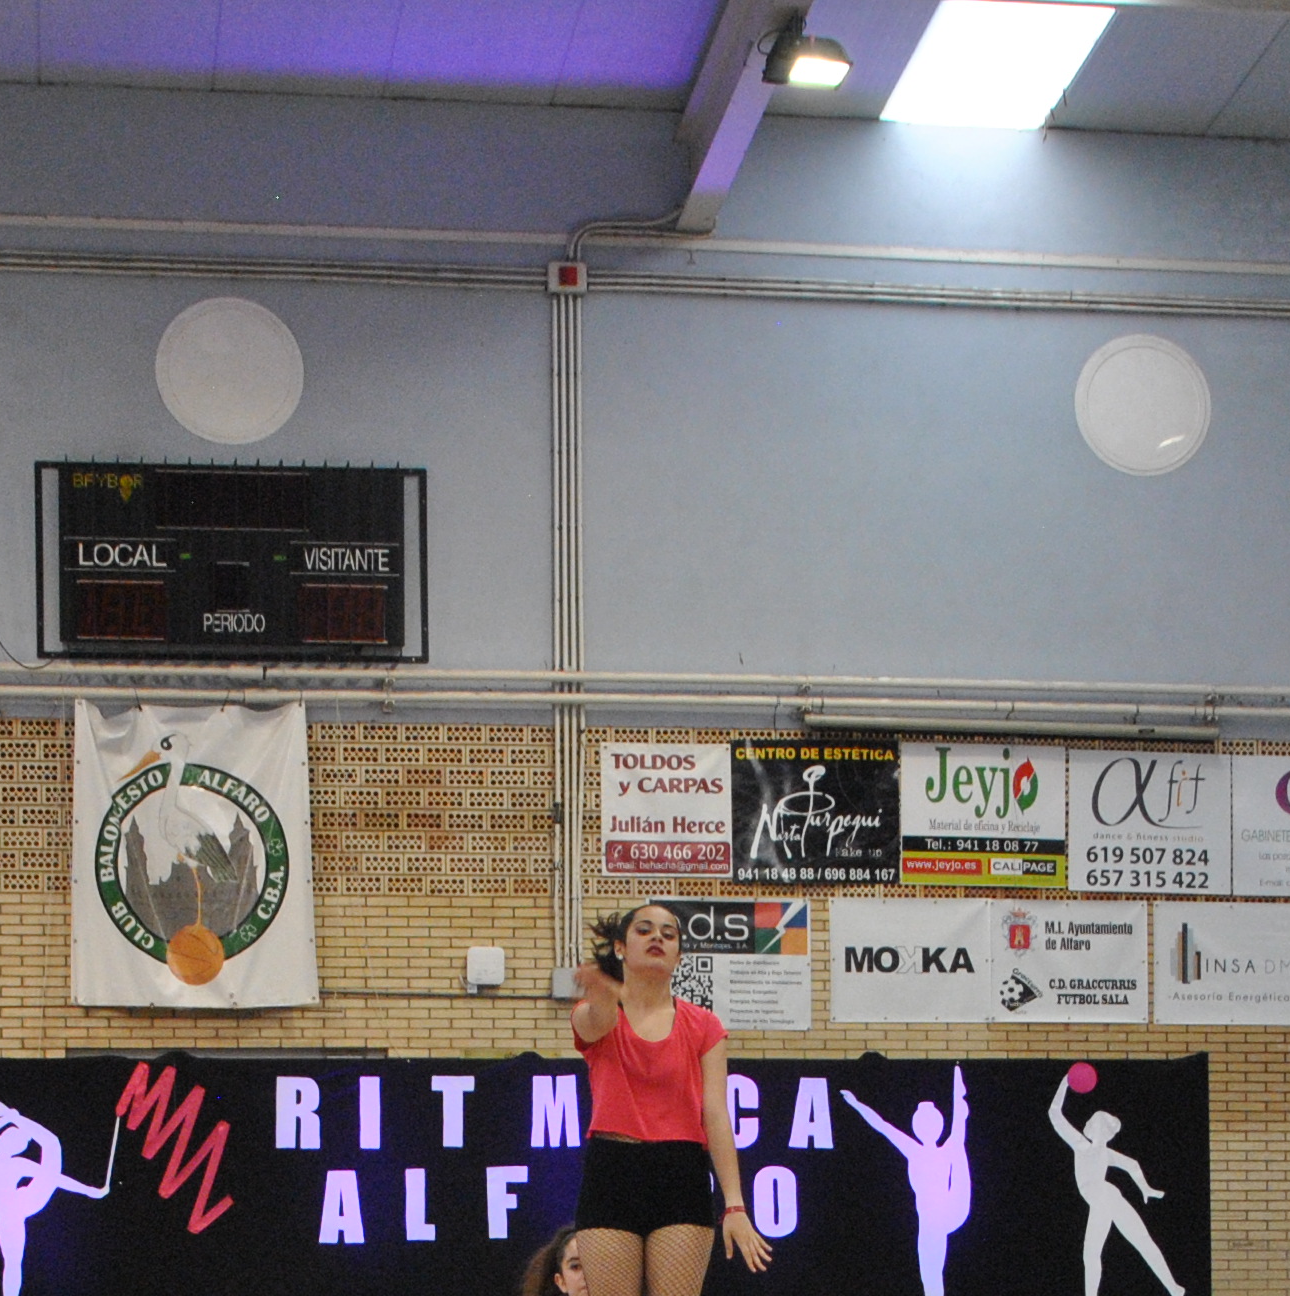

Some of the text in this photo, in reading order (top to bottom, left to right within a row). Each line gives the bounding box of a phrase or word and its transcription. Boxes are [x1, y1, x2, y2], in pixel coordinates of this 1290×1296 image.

[78, 543, 167, 568] LOCAL
[304, 547, 390, 572] VISITANTE
[203, 613, 266, 633] PERIODO
[611, 753, 696, 770] TOLDOS
[735, 748, 796, 760] CENTRO
[801, 748, 819, 760] DE
[619, 777, 724, 796] y CARPAS
[609, 815, 726, 834] Julián Herce
[929, 820, 961, 831] Material
[963, 821, 973, 831] de
[974, 820, 999, 832] oficina
[1008, 821, 1040, 837] Reciclaje
[925, 838, 1039, 852] Tel.: 941 18 08 77
[1093, 832, 1123, 840] dance
[1136, 832, 1169, 841] fitness
[1172, 834, 1204, 843] studio
[100, 769, 285, 949] CLUB BALONCESTO ALFARO C.B.A.
[630, 844, 725, 860] 630 466 202
[1086, 846, 1210, 866] 619 507 824
[906, 860, 976, 870] www.jeyjo.es
[738, 868, 759, 880] 941
[764, 868, 778, 880] 18
[782, 868, 796, 880] 48
[800, 868, 814, 880] 88
[825, 868, 846, 880] 696
[849, 868, 870, 880] 884
[874, 868, 895, 881] 167
[1086, 869, 1209, 889] 657 315 422
[674, 905, 750, 941] .d.s
[1067, 921, 1133, 936] Ayuntamiento
[1045, 937, 1091, 951] de Alfaro
[1048, 979, 1138, 991] C.D. GRACCURRIS
[1056, 994, 1130, 1006] FUTBOL SALA
[275, 1074, 834, 1149] RITMCA
[319, 1165, 798, 1244] ALFO
